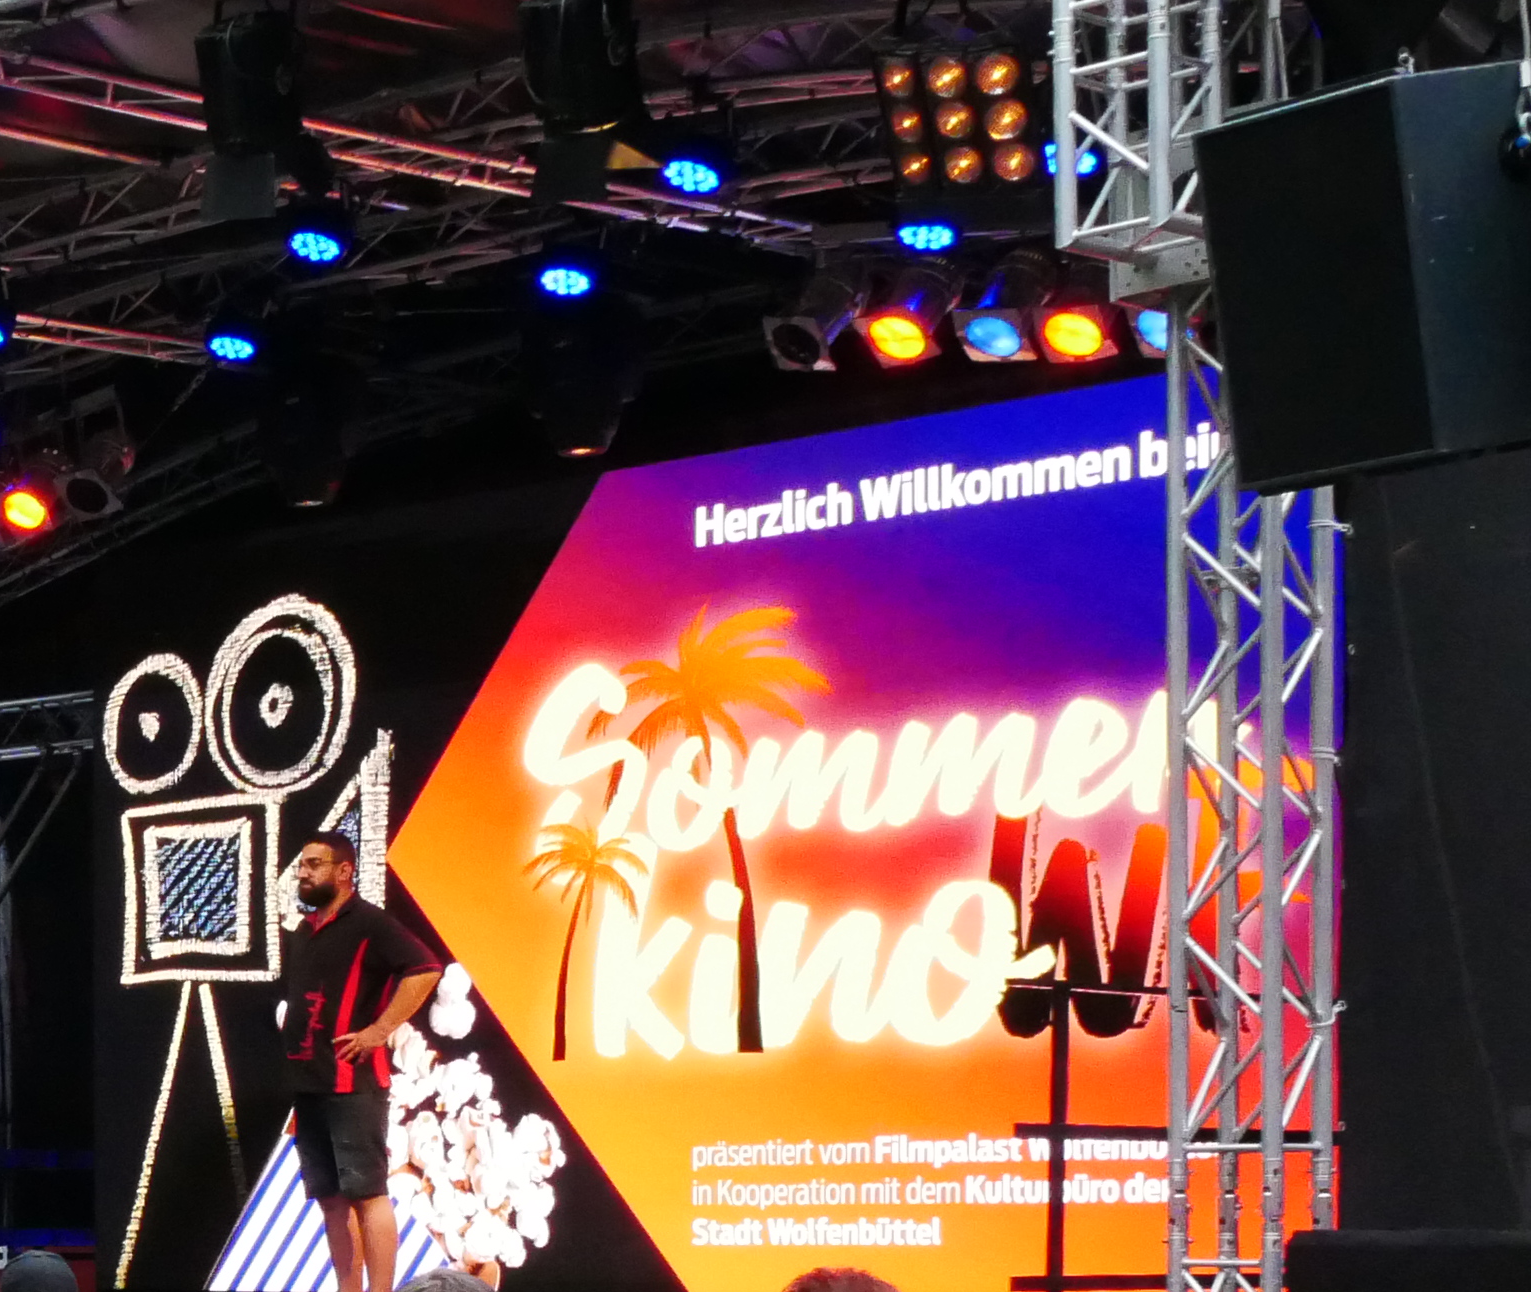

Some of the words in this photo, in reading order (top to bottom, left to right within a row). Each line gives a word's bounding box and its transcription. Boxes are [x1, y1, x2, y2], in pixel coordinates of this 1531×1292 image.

[693, 483, 853, 548] Herzlich
[860, 442, 1131, 521] Willkommen
[523, 662, 1253, 880] Sommer
[591, 834, 1056, 1060] kino
[692, 1138, 815, 1172] präsentiert
[818, 1141, 871, 1165] vom
[874, 1131, 1028, 1169] Filmpalast
[692, 1179, 713, 1206] in
[717, 1178, 856, 1210] Kooperation
[860, 1176, 901, 1206] mit
[905, 1174, 962, 1206] dem
[691, 1217, 764, 1246] Stadt
[767, 1216, 943, 1246] Wolfenbüttel
